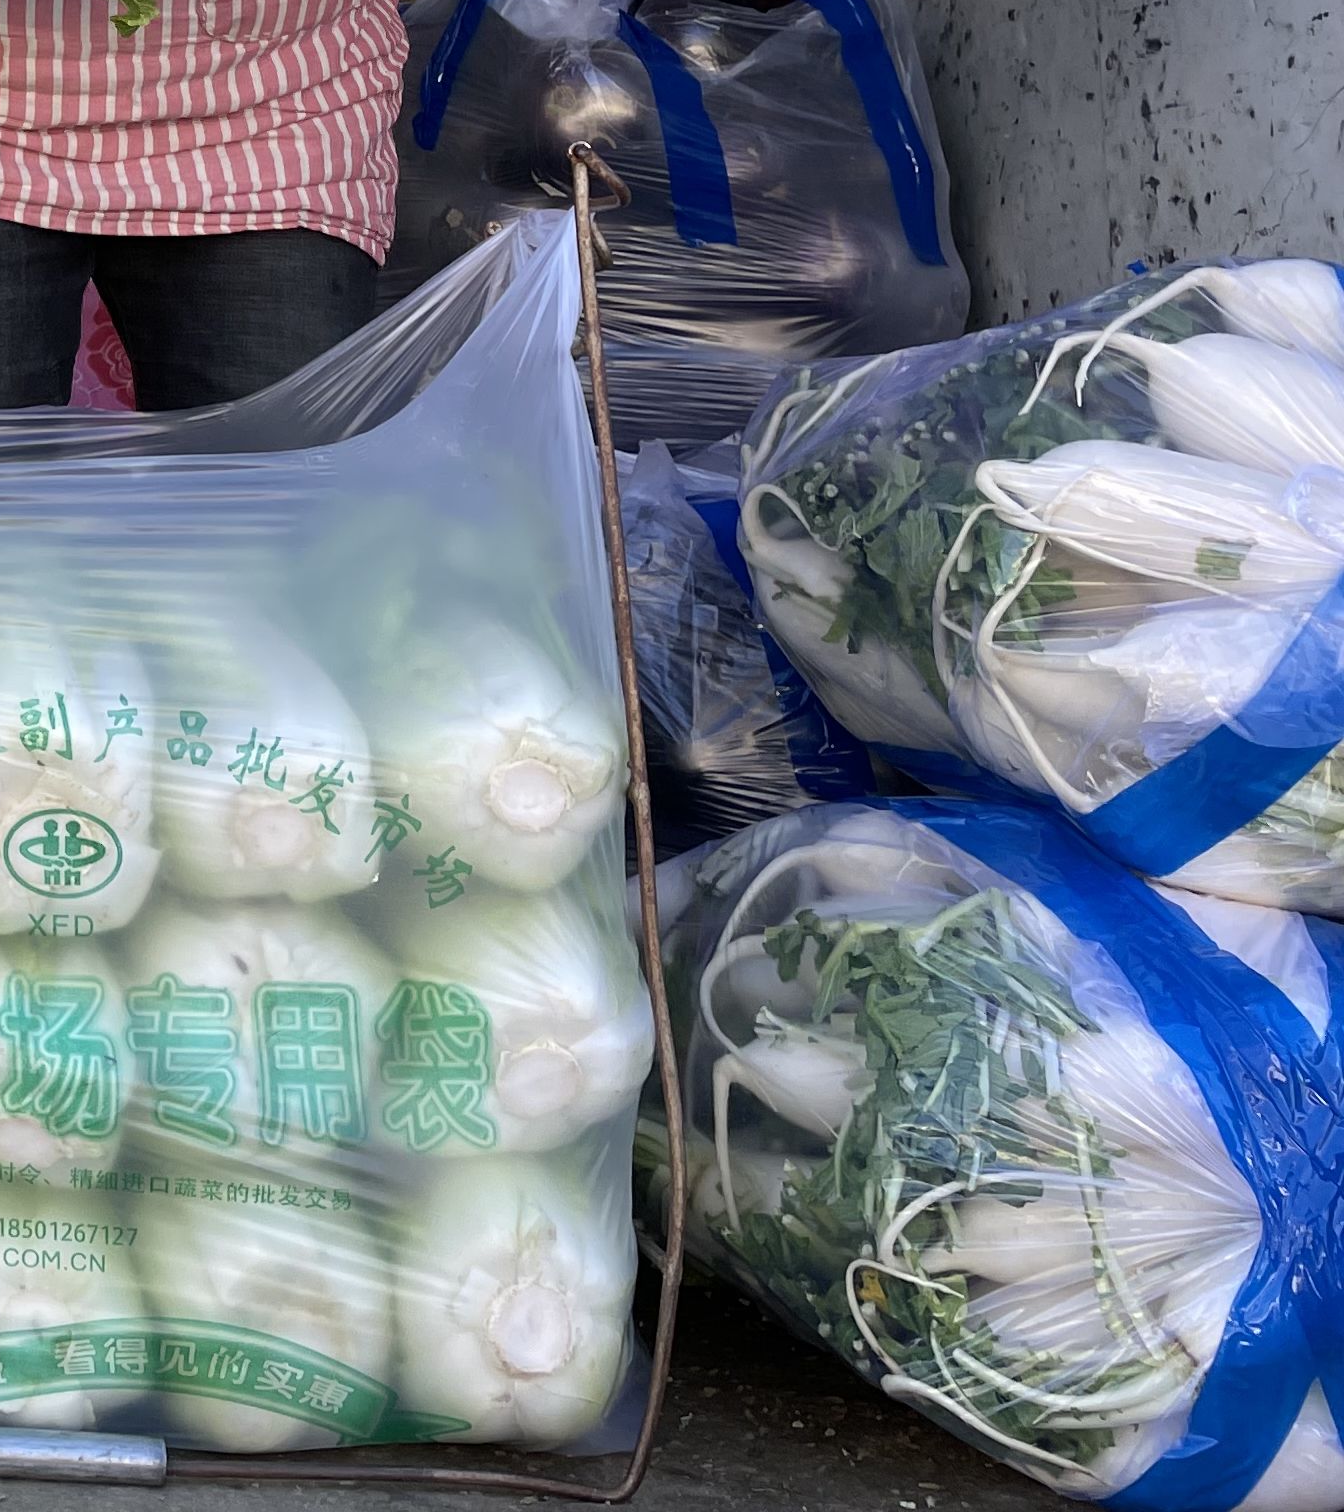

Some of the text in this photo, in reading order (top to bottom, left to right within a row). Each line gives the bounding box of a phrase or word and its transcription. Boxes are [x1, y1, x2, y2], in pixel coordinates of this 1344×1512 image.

[28, 913, 94, 937] XFD
[54, 1338, 354, 1414] 看得见的实惠
